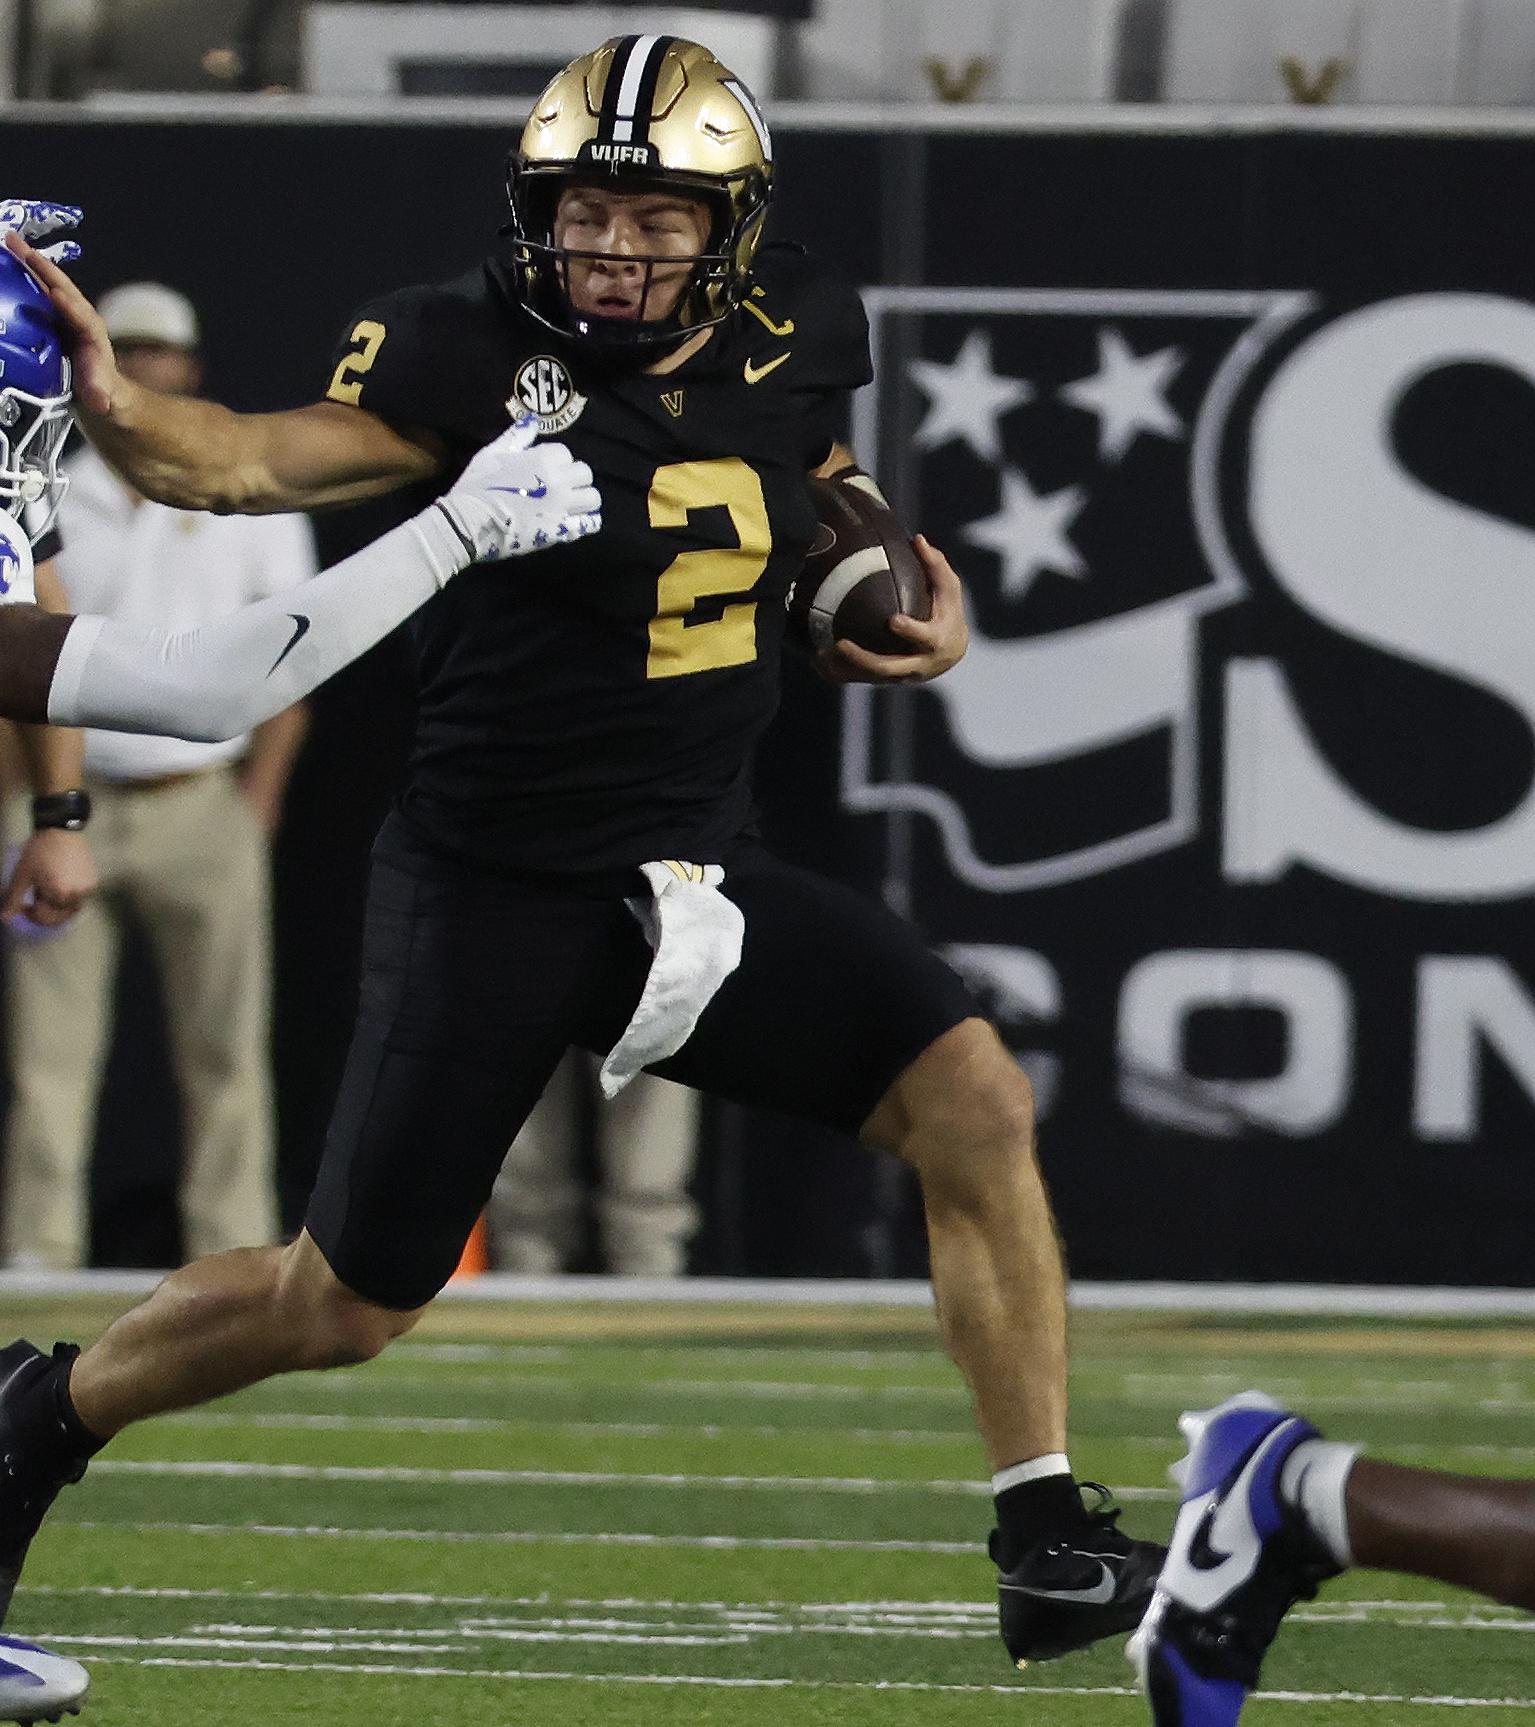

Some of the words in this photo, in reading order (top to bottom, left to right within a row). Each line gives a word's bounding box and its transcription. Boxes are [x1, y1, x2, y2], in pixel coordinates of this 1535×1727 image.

[326, 319, 386, 407] 2
[520, 359, 568, 414] SEC
[647, 457, 772, 679] 2
